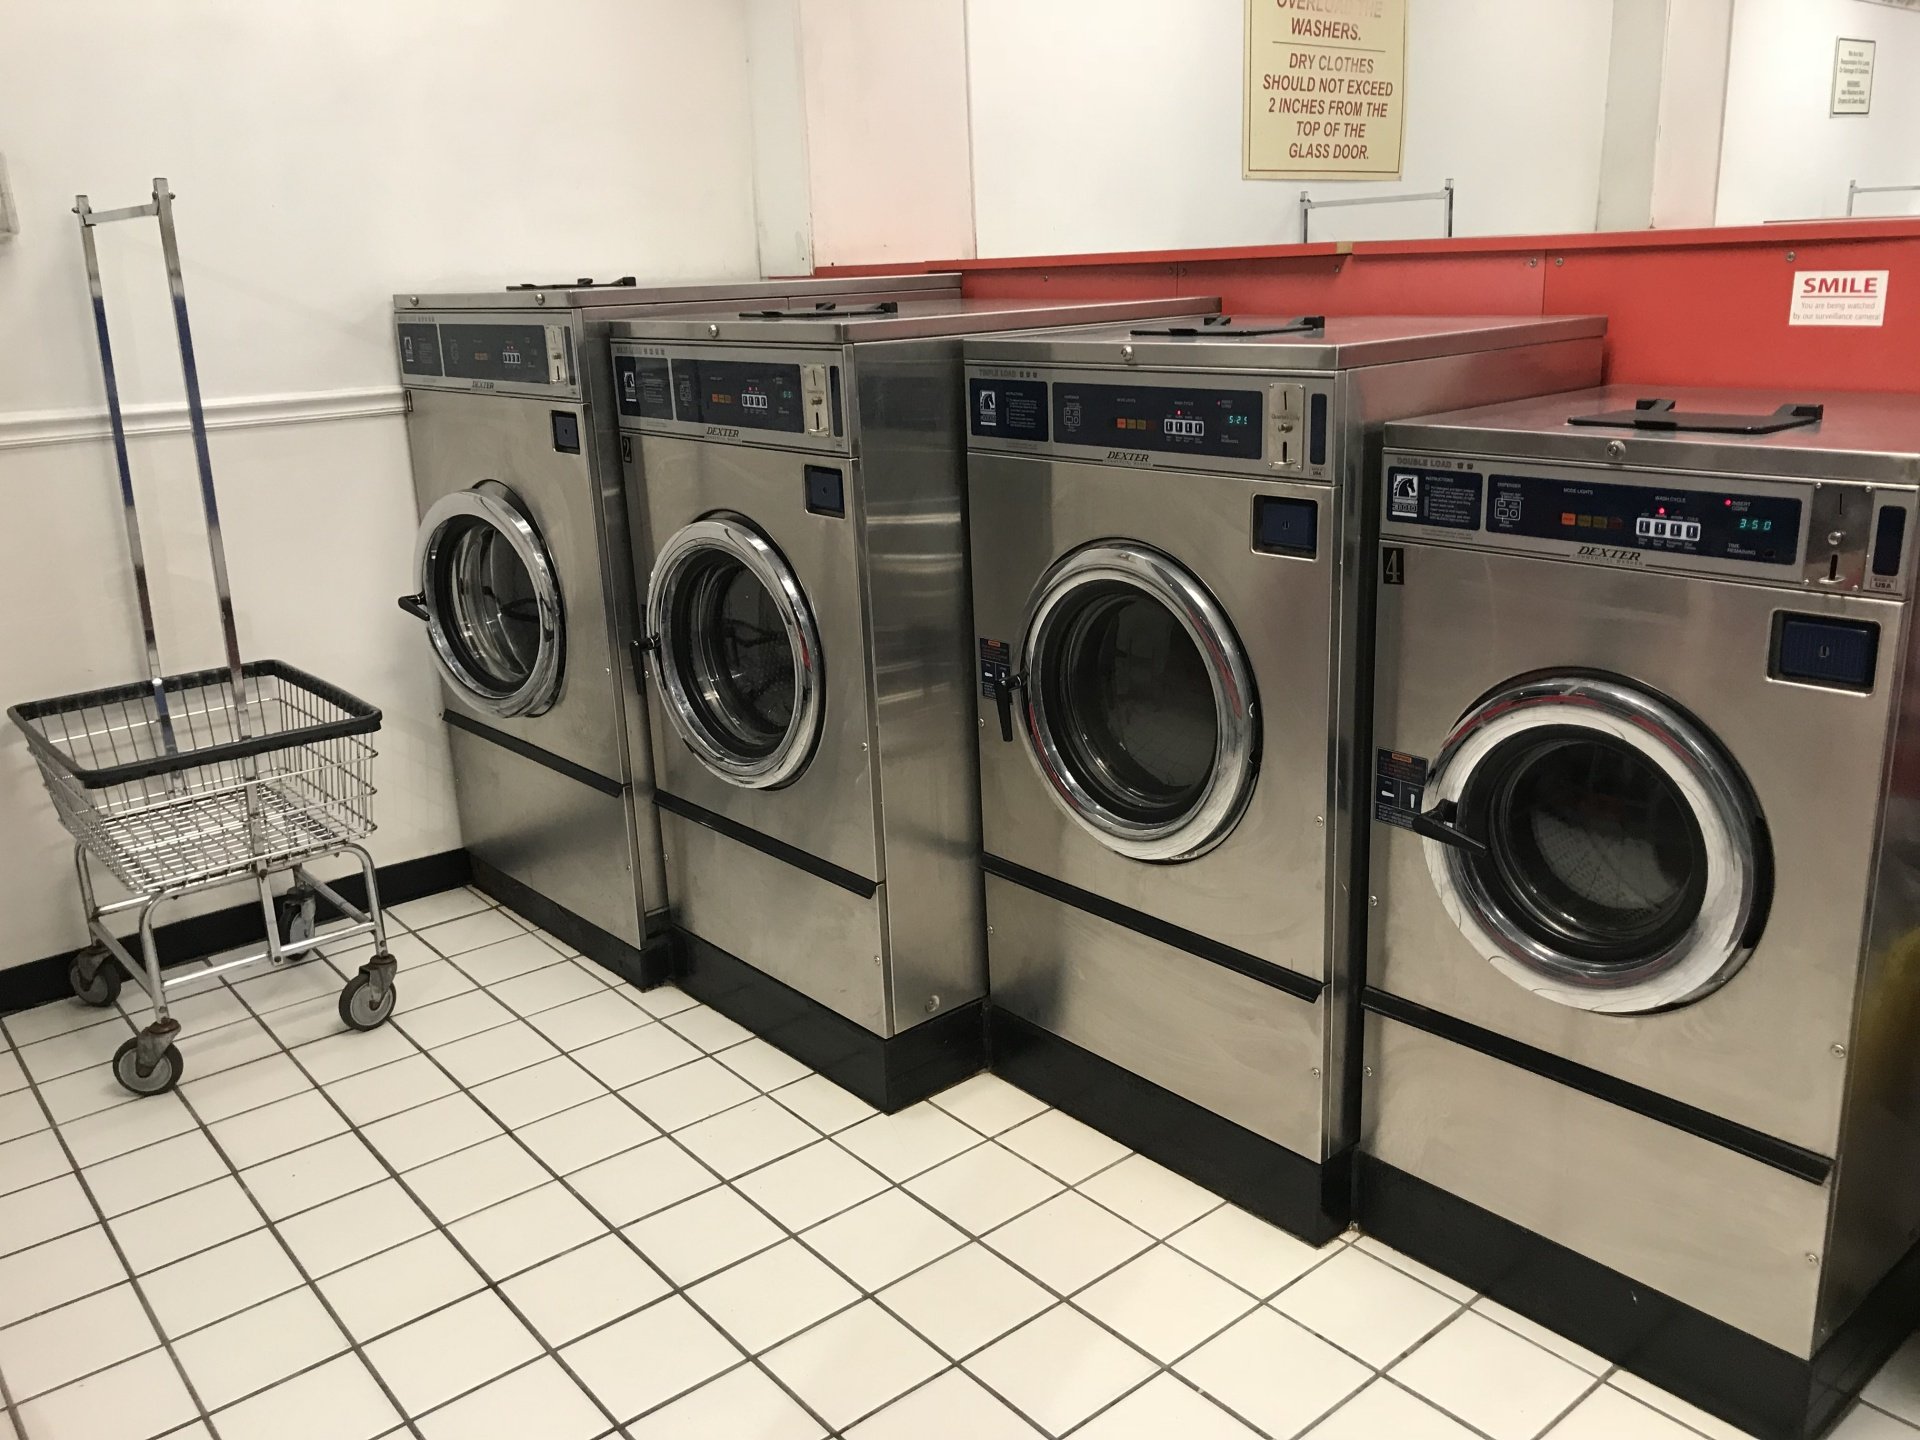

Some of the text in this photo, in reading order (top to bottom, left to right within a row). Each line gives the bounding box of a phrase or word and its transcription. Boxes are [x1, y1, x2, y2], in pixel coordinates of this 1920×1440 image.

[1291, 17, 1361, 41] WASHERS.
[1289, 52, 1374, 74] DRY CLOTHES
[1263, 74, 1393, 97] SHOULD NOT EXCEED
[1268, 97, 1388, 118] 2 INCHES FROM THE
[1296, 121, 1366, 138] TOP OF THE
[1289, 143, 1369, 160] GLASS DOOR.
[1803, 277, 1878, 293] SMILE
[1826, 302, 1846, 311] being
[1847, 302, 1876, 310] watched
[1793, 312, 1800, 320] by
[1815, 312, 1853, 320] surveillance
[706, 426, 739, 437] DEXTER
[1107, 450, 1149, 462] DEXTER
[1397, 457, 1452, 468] DOUBLE LOAD
[1578, 546, 1641, 561] DEXTER
[1386, 550, 1400, 582] 4
